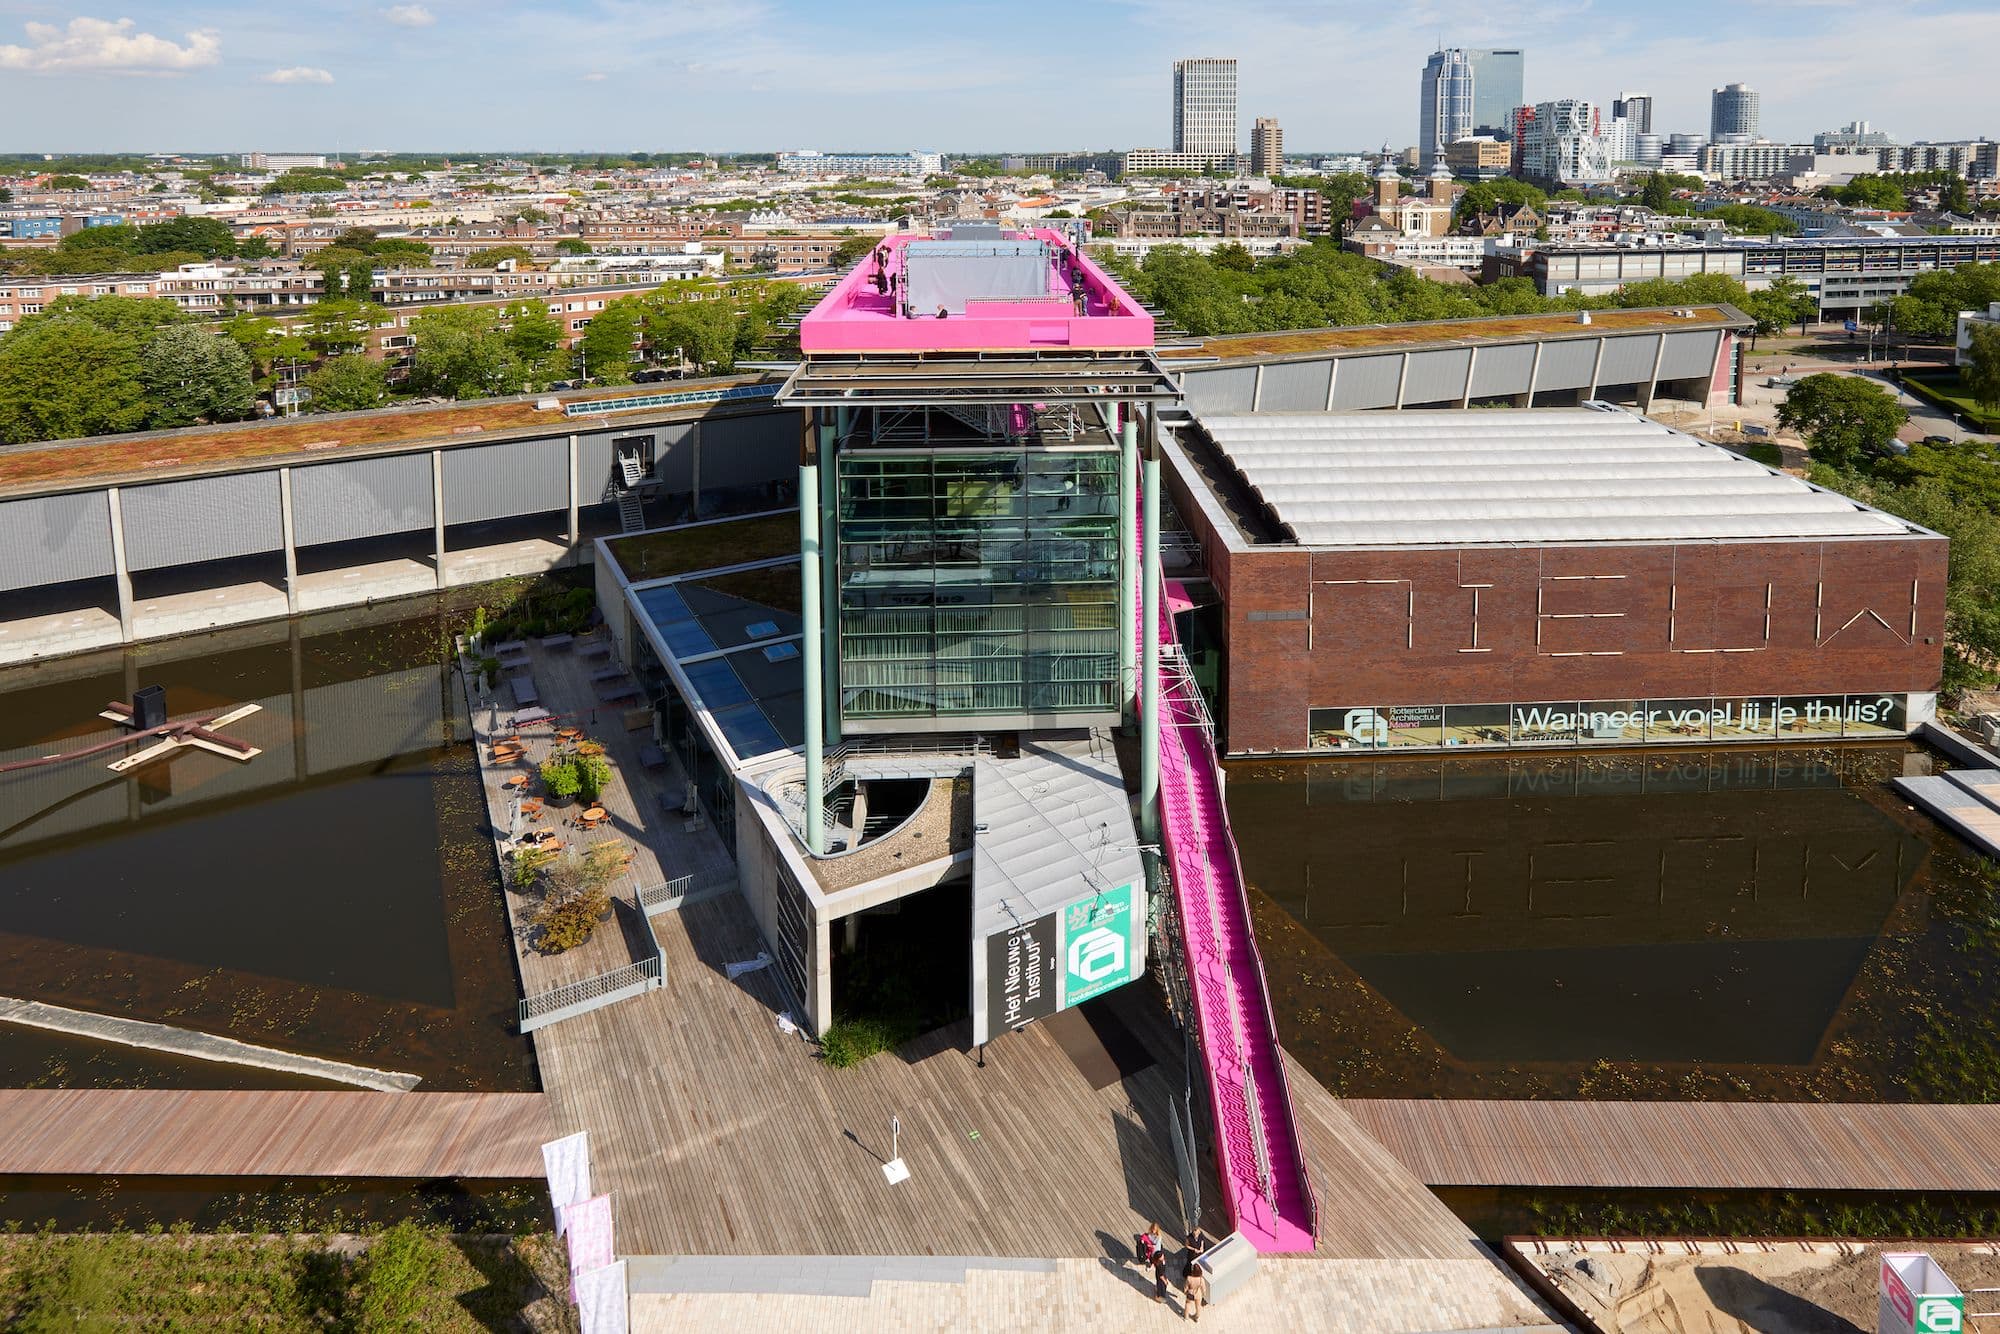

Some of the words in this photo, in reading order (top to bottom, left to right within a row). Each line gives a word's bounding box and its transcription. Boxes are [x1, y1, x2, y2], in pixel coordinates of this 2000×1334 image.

[1517, 707, 1662, 730] Wanneer
[1667, 702, 1731, 727] voel
[1738, 702, 1760, 730] jij
[1768, 702, 1796, 729] je
[1804, 698, 1894, 723] thuis?
[1005, 936, 1021, 993] Nieuwe
[1025, 942, 1041, 1003] Instituut
[1005, 994, 1021, 1023] Het
